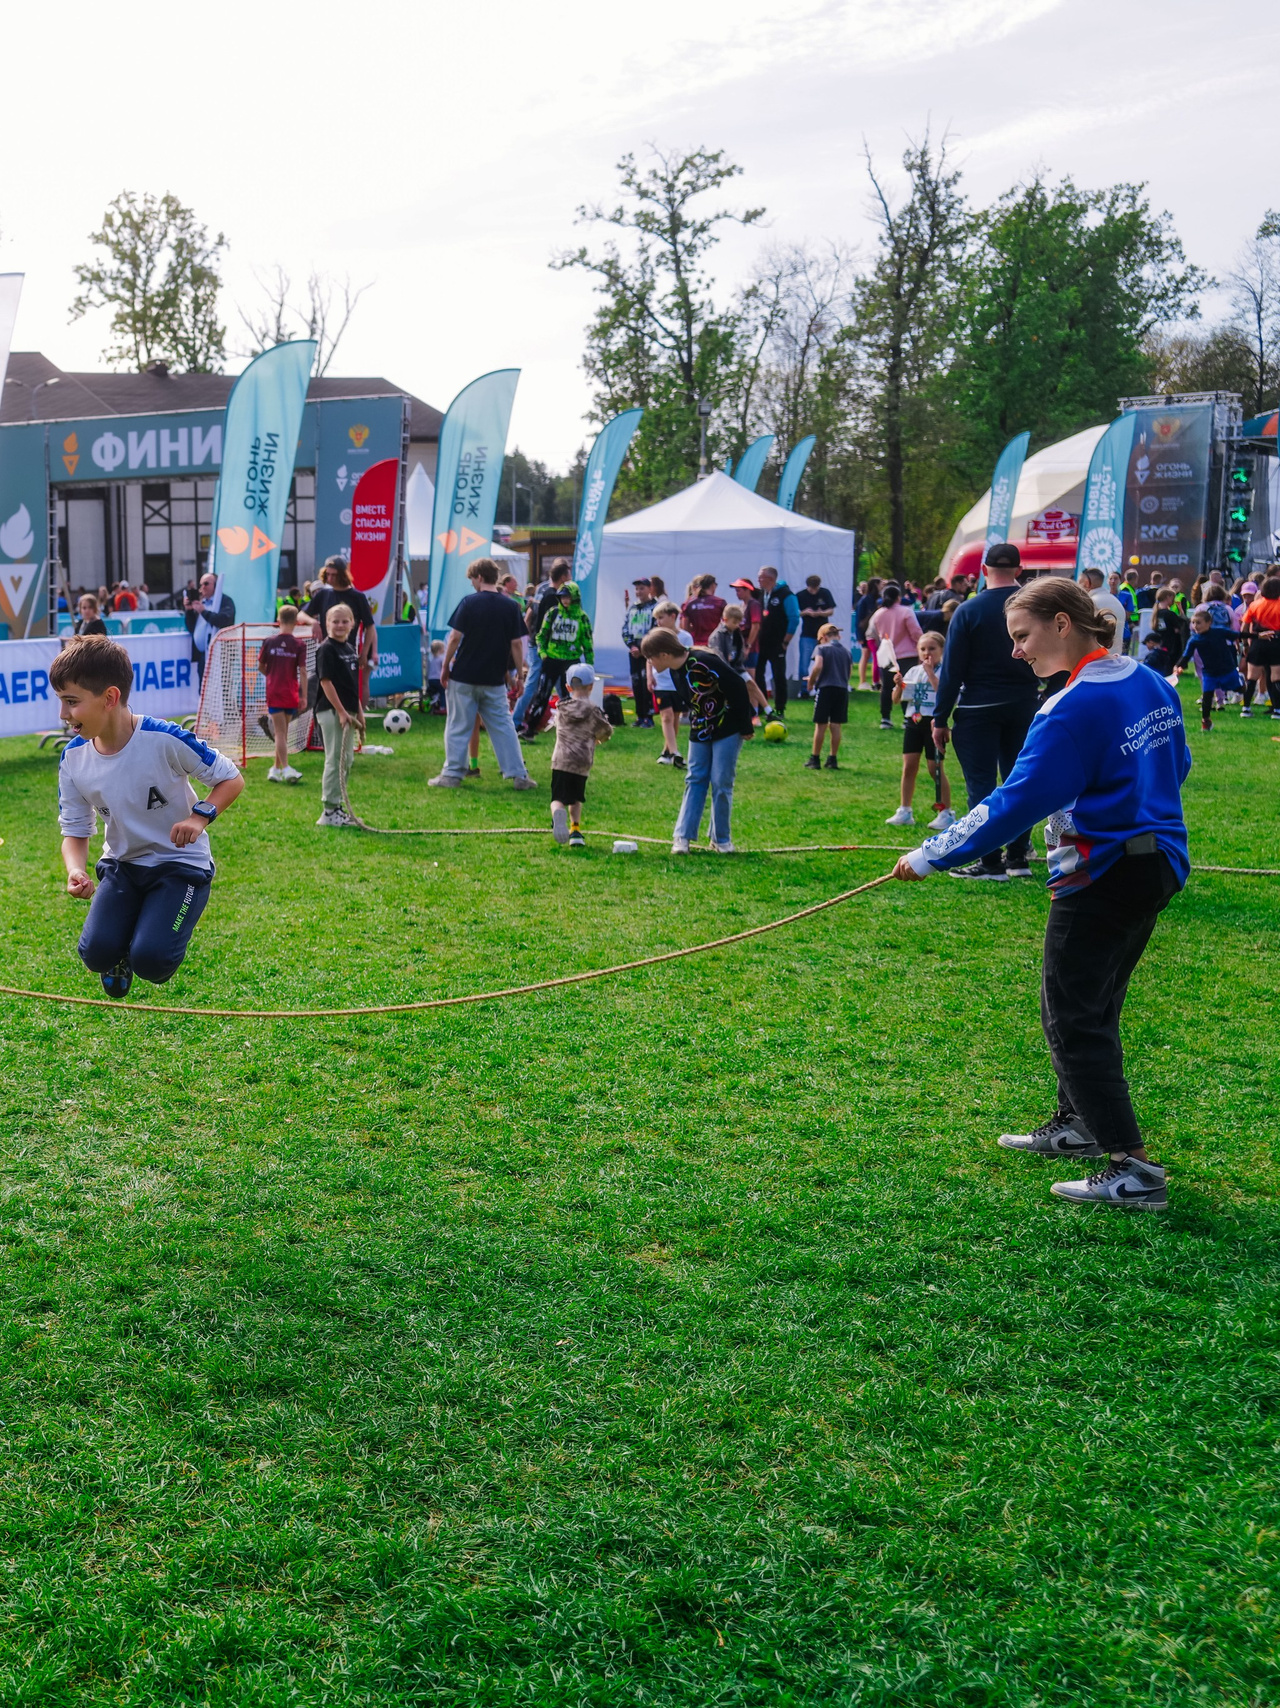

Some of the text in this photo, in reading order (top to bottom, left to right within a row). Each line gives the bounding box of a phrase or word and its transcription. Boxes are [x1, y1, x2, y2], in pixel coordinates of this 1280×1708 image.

[91, 425, 222, 472] ФИНИ
[244, 436, 261, 510] ОГОНЬ
[257, 432, 280, 518] ЖИЗНИ
[454, 452, 472, 514] ОГОНЬ
[467, 446, 488, 518] ЖИЗНИ
[1088, 473, 1102, 520] NOBLE
[1099, 464, 1112, 520] IMPACT
[355, 505, 387, 515] ВМЕСТЕ
[355, 518, 391, 528] СПАСАЕМ
[1141, 554, 1189, 565] MAER
[377, 652, 399, 665] ГОНЬ
[147, 786, 168, 810] A
[172, 883, 196, 932] MAKE THE FUTURE
